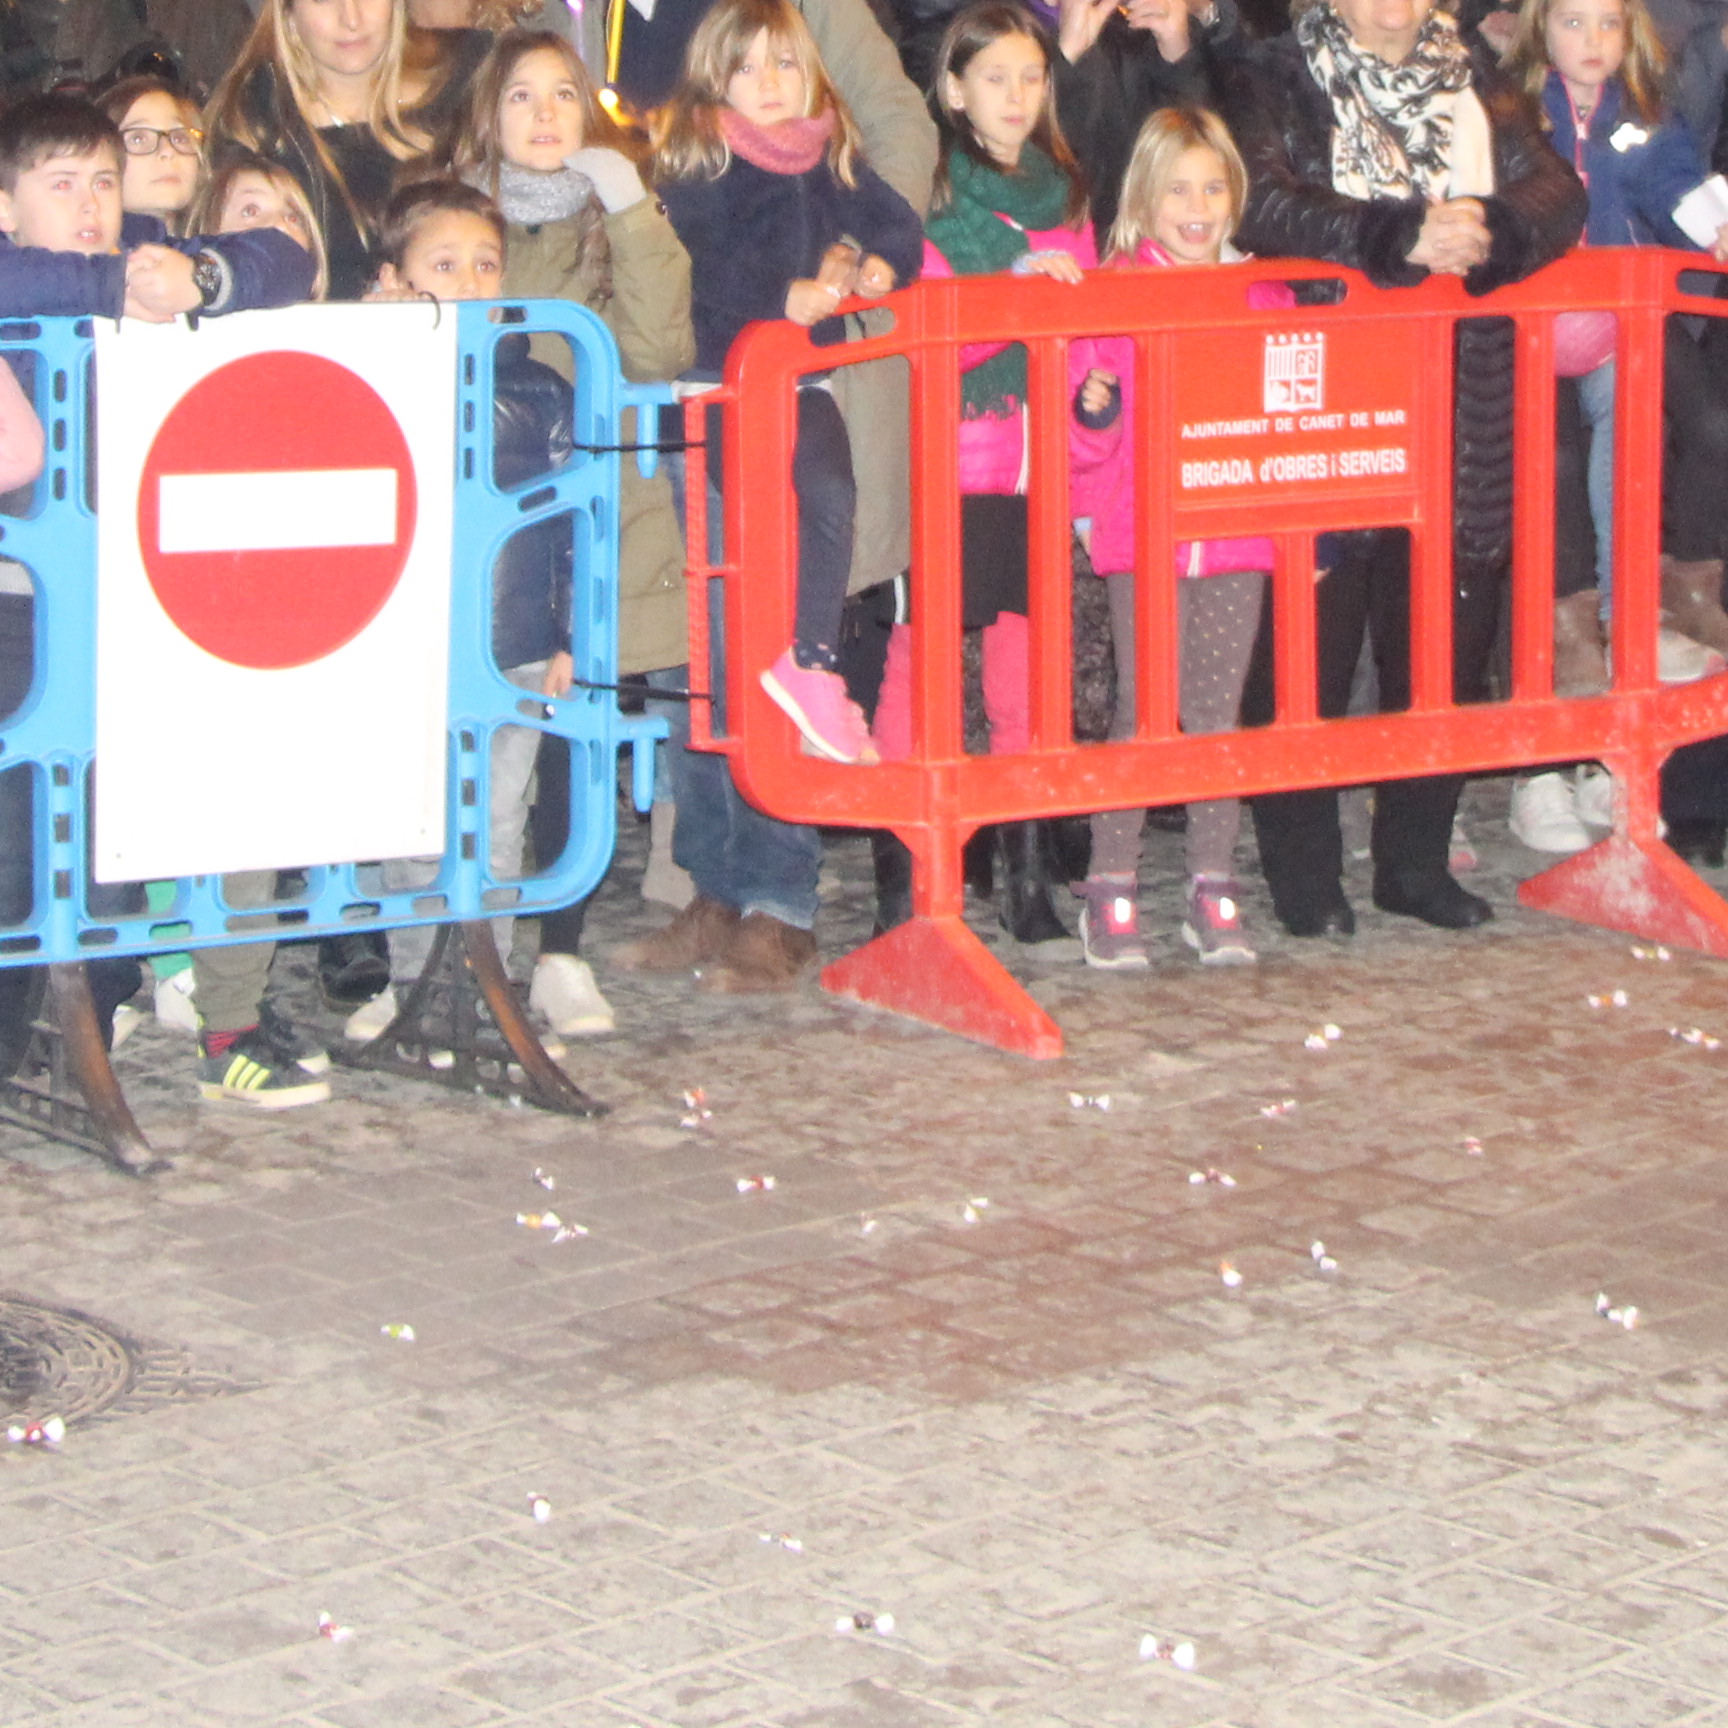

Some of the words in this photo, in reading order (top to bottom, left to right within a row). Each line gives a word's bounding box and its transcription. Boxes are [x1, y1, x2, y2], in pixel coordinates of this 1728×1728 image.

[1181, 418, 1269, 440] AJUNTAMENT
[1275, 417, 1293, 432] DE
[1299, 414, 1344, 430] CANET
[1350, 412, 1368, 427] DE
[1374, 409, 1406, 425] MAR
[1181, 458, 1254, 489] BRIGADA
[1259, 453, 1326, 482] d'OBRES
[1339, 447, 1406, 475] SERVEIS
